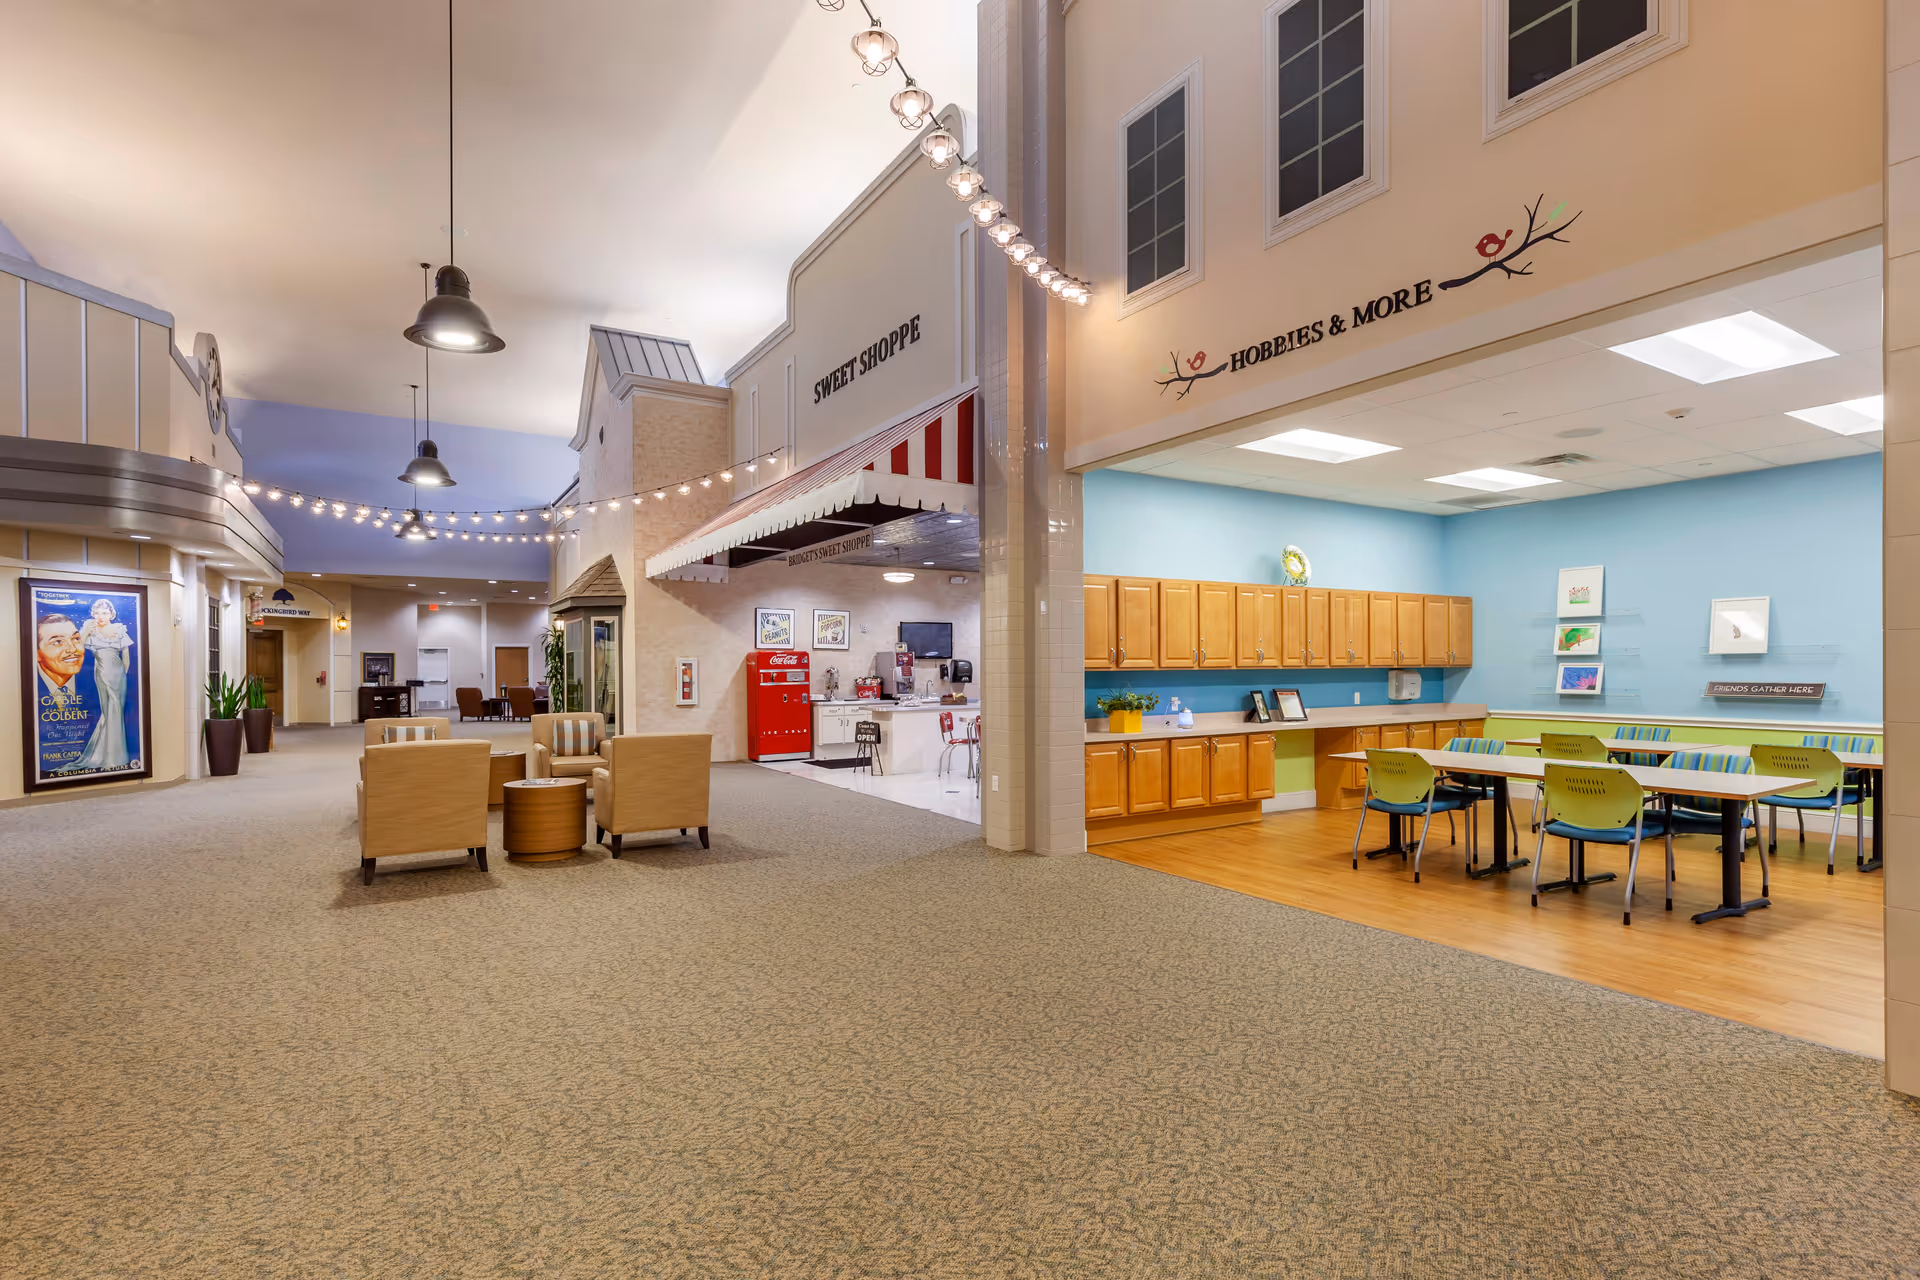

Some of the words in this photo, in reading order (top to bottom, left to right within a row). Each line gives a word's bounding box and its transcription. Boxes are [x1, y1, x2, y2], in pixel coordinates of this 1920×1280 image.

[1230, 320, 1324, 372] HOBBIES
[1329, 314, 1347, 336] &
[1352, 279, 1433, 328] MORE
[814, 356, 857, 404] SWEET
[859, 314, 920, 376] SHOPPE
[788, 549, 818, 567] BRIDGET'S
[819, 542, 841, 559] SWEET
[842, 534, 871, 553] SHOPPE
[820, 620, 842, 632] POPCORN
[764, 627, 788, 642] PEANUTS
[1751, 685, 1787, 693] GATHER
[1789, 686, 1814, 694] HERE
[41, 695, 82, 705] GABLE
[41, 710, 88, 722] COLBERT
[857, 734, 876, 742] OPEN
[58, 768, 97, 777] COLUMBIA
